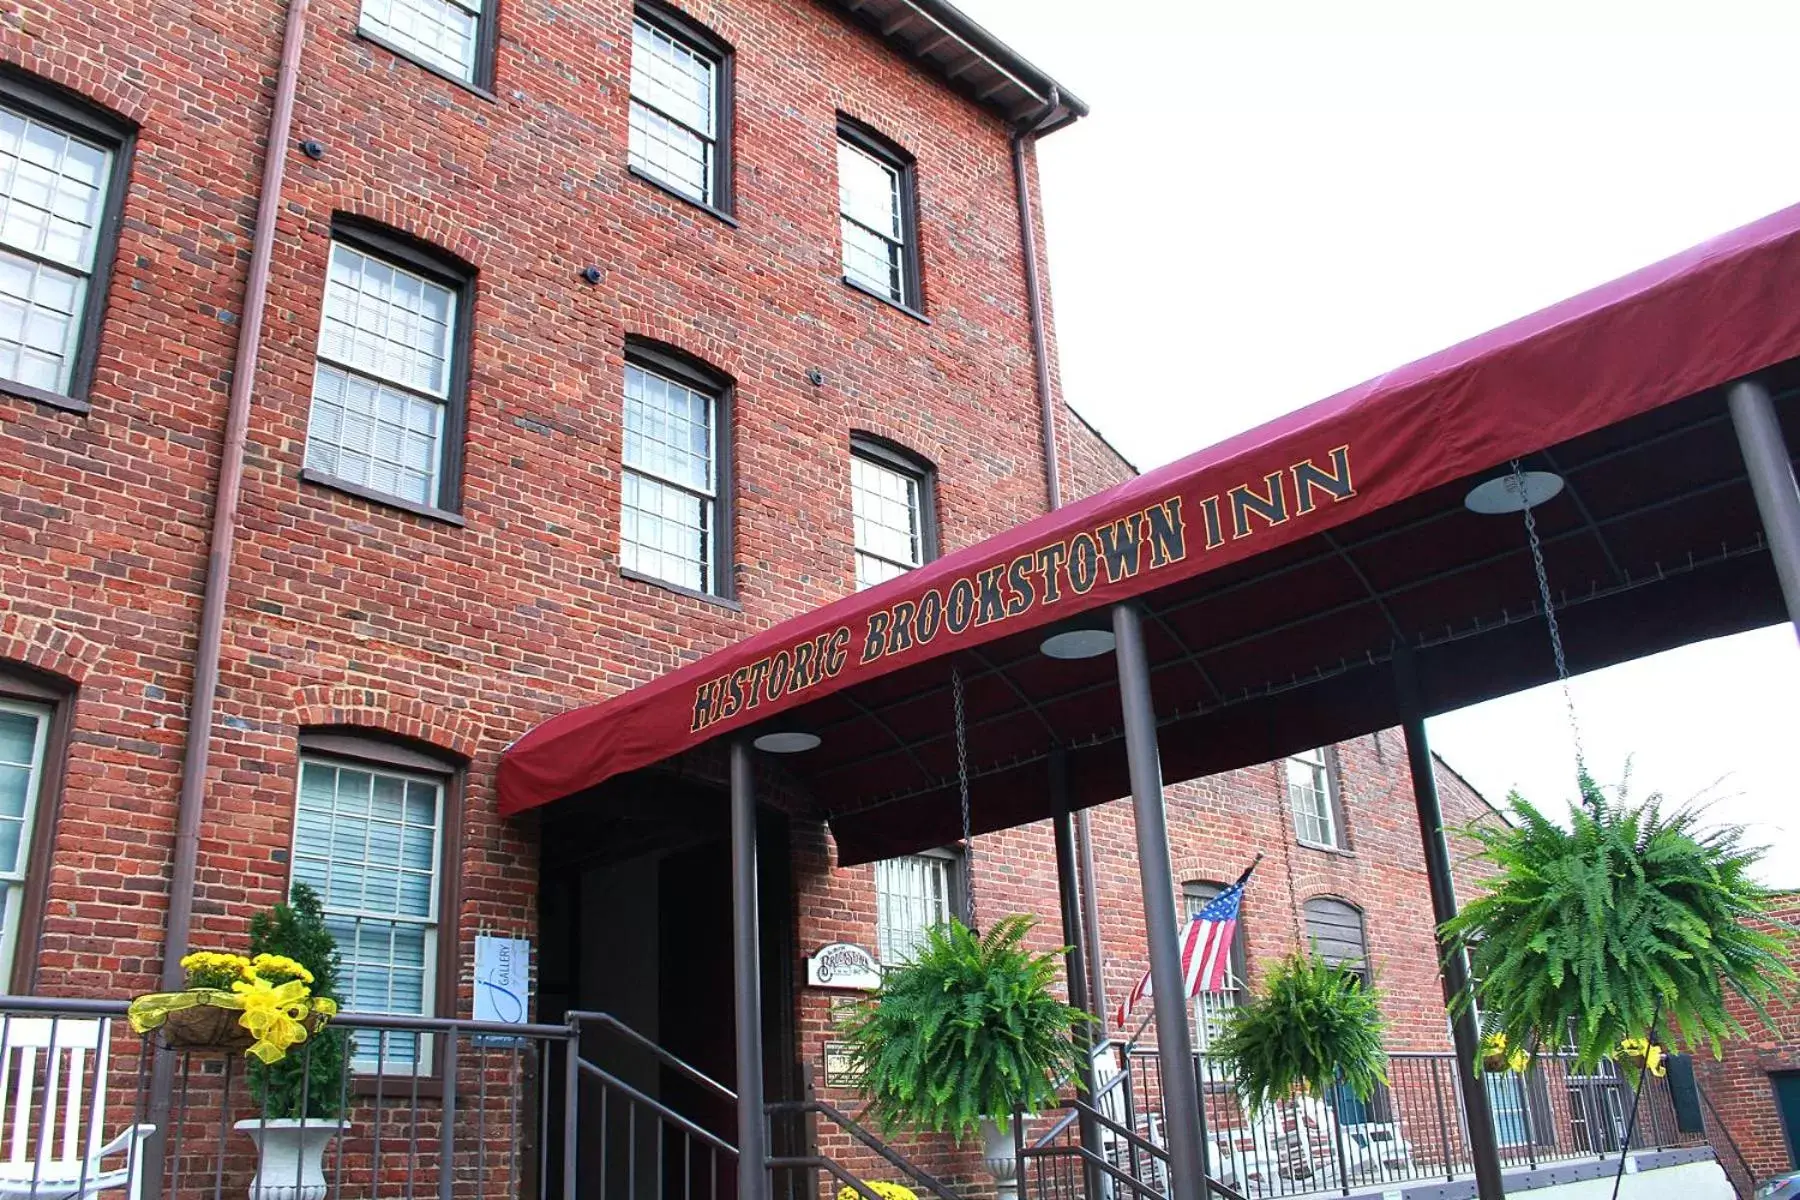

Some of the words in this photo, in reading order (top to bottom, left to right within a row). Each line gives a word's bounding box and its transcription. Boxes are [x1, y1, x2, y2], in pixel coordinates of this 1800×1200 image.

[690, 626, 851, 733] HISTORIC
[860, 496, 1187, 665] BROOKSTOWN
[1200, 444, 1357, 550] INN
[498, 944, 511, 987] GALLERY
